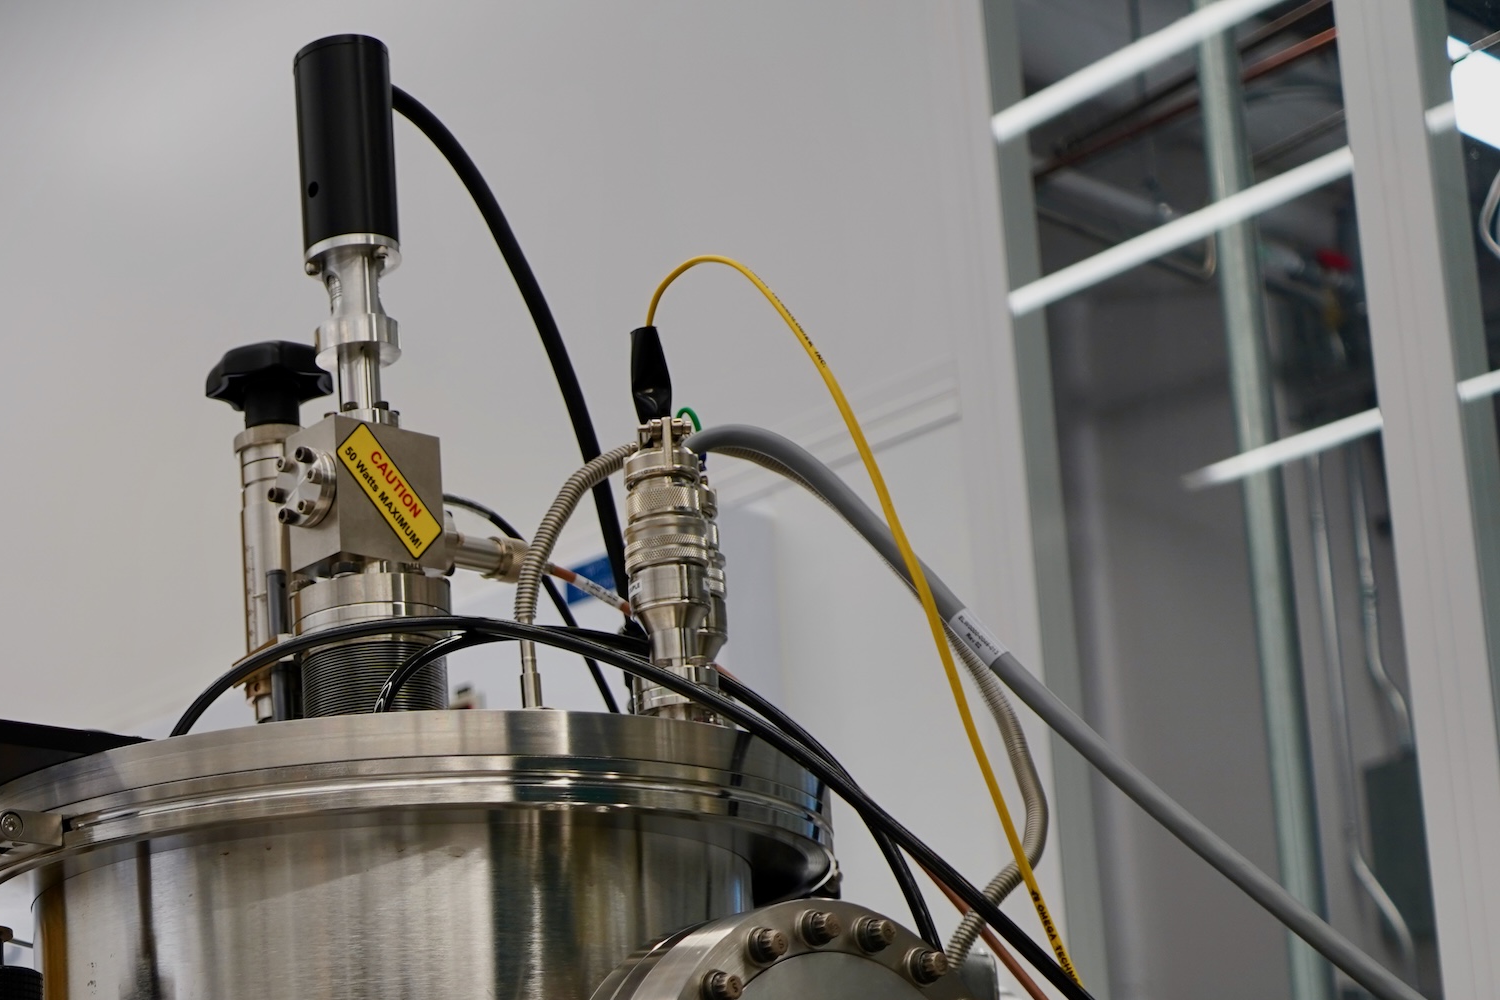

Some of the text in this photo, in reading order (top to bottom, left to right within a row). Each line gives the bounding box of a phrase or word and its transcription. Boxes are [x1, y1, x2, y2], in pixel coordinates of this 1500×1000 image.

[344, 446, 422, 549] 50 Watts MAXIMUM!
[370, 451, 422, 518] CAUTION
[1037, 904, 1057, 941] OMEGA
[1055, 944, 1079, 983] TECHNO
